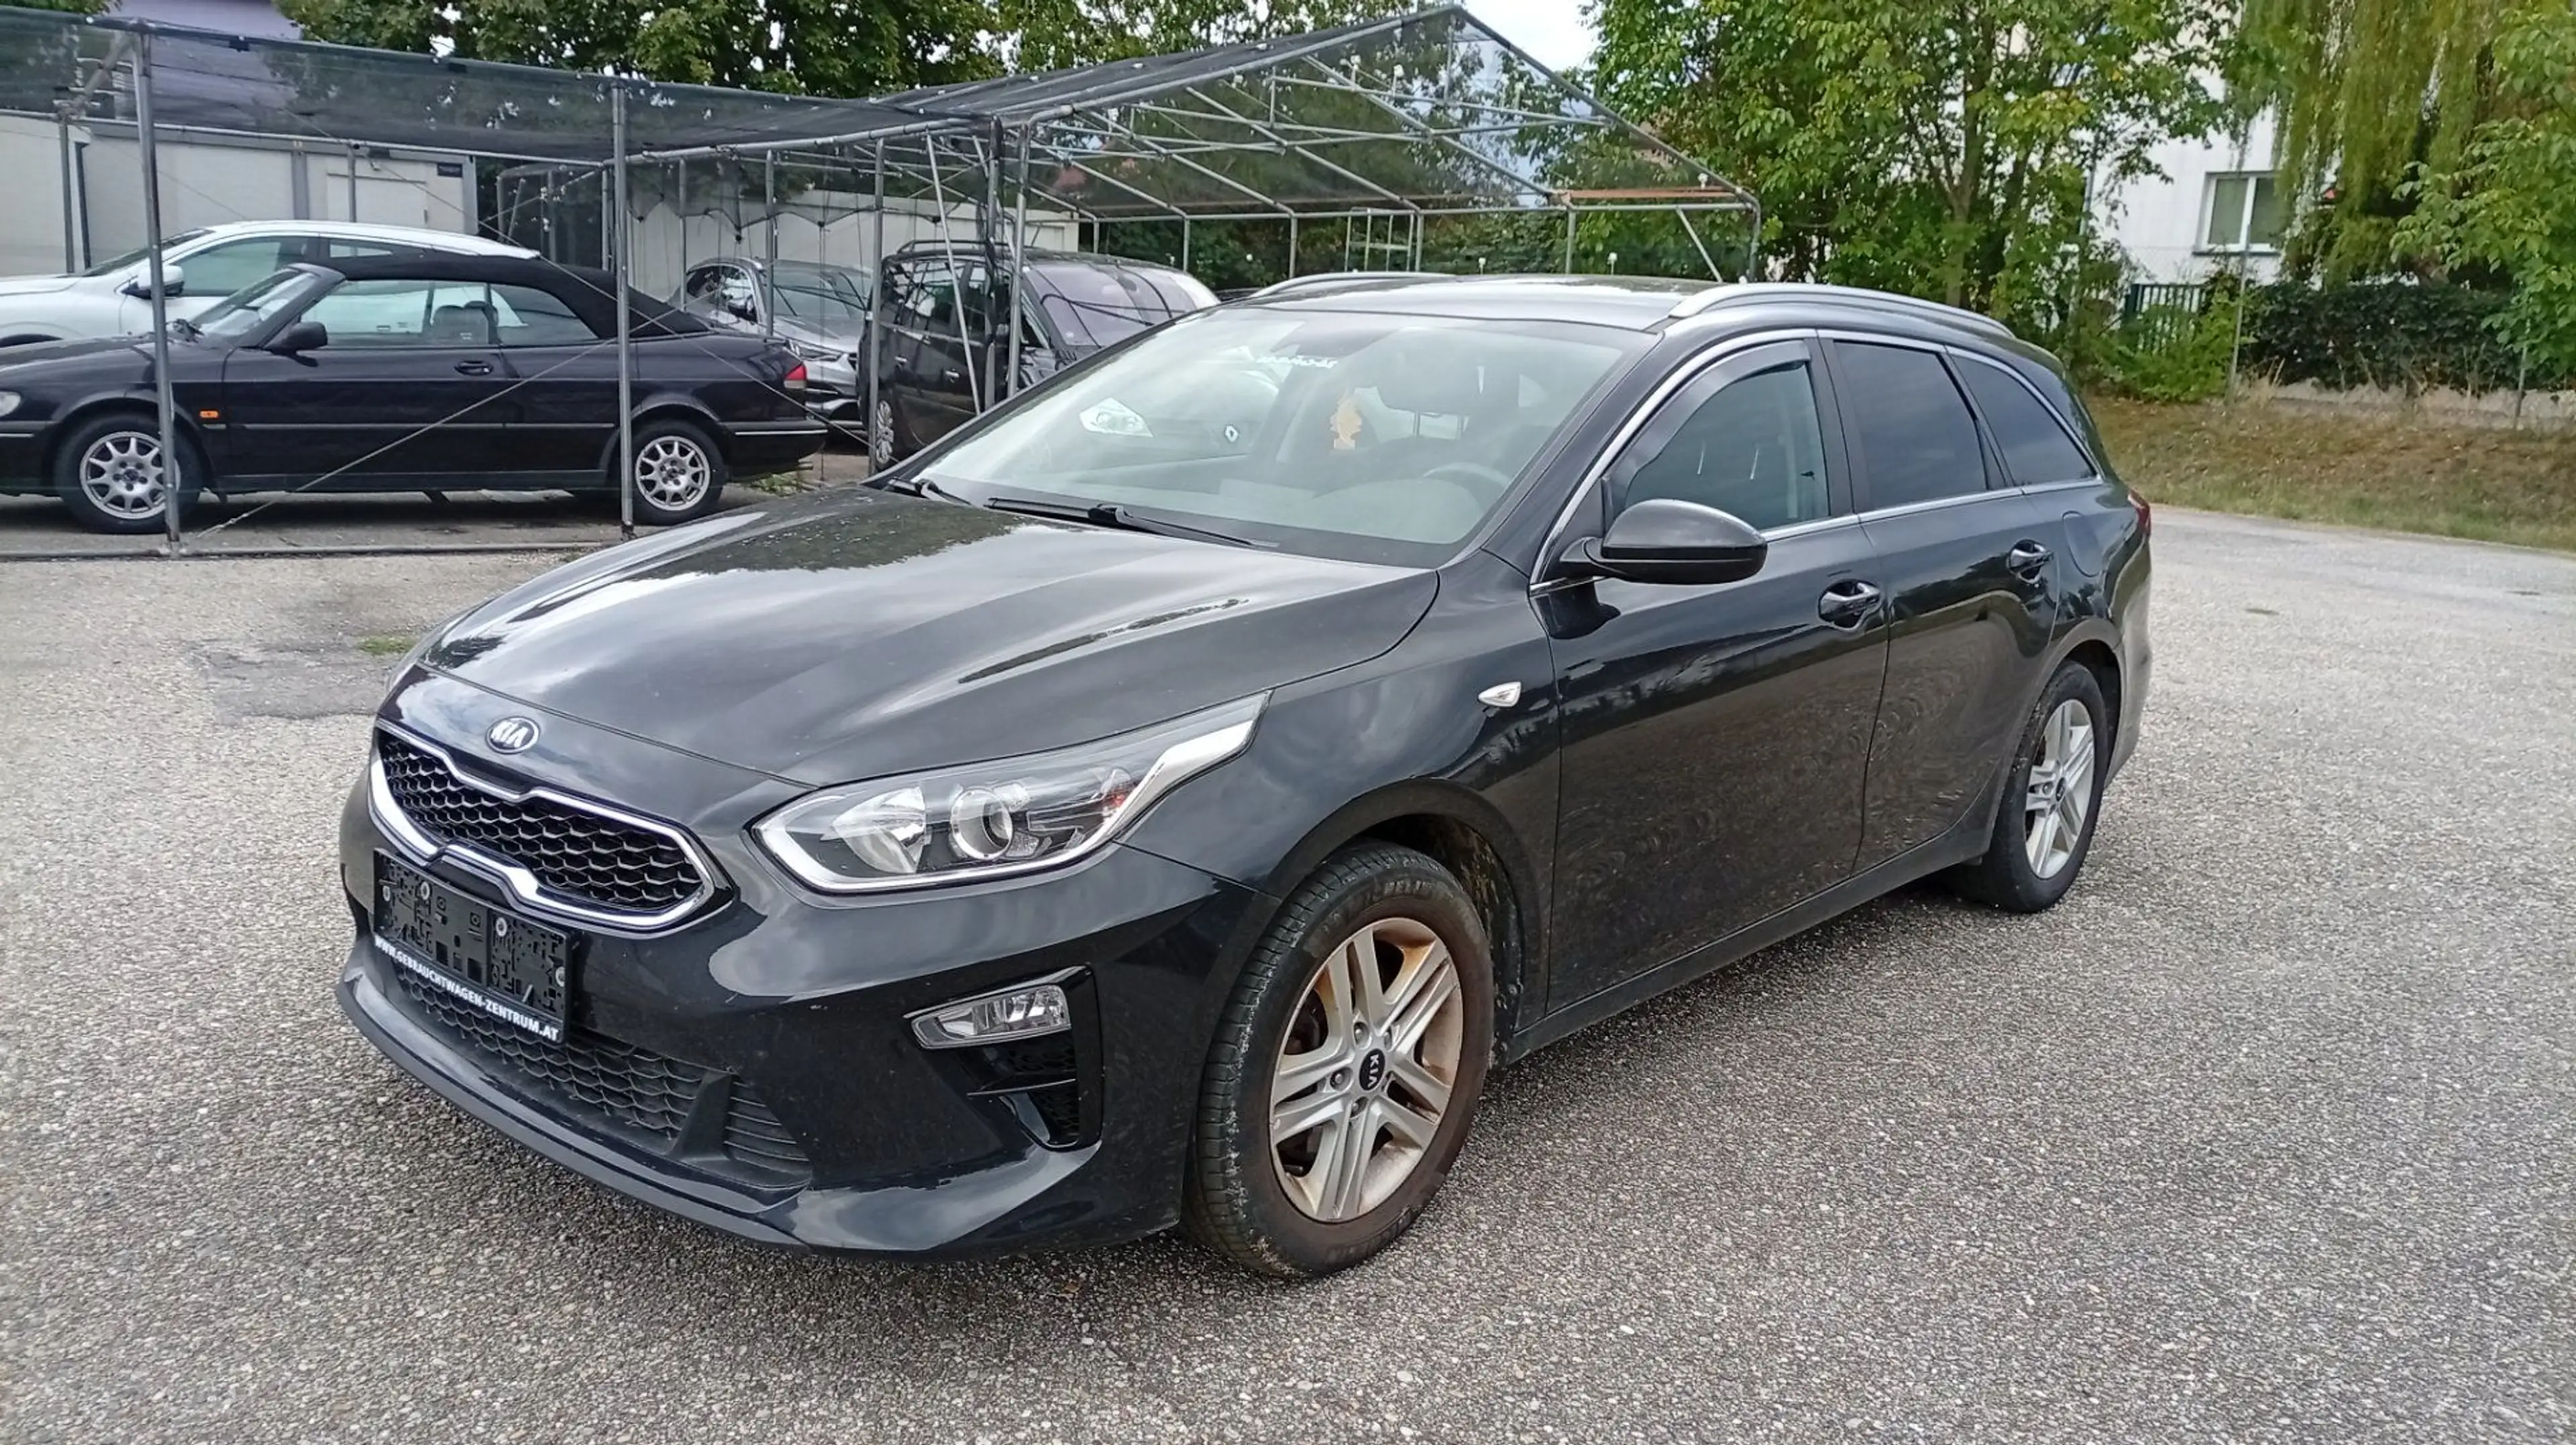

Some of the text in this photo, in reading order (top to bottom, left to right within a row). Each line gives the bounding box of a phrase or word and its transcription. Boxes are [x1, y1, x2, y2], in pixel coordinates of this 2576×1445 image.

[490, 720, 529, 748] KIA
[374, 934, 559, 1041] WWW.GEBRAUCHTWAGEN-ZENTRUM.AT
[1368, 1054, 1379, 1088] KIA
